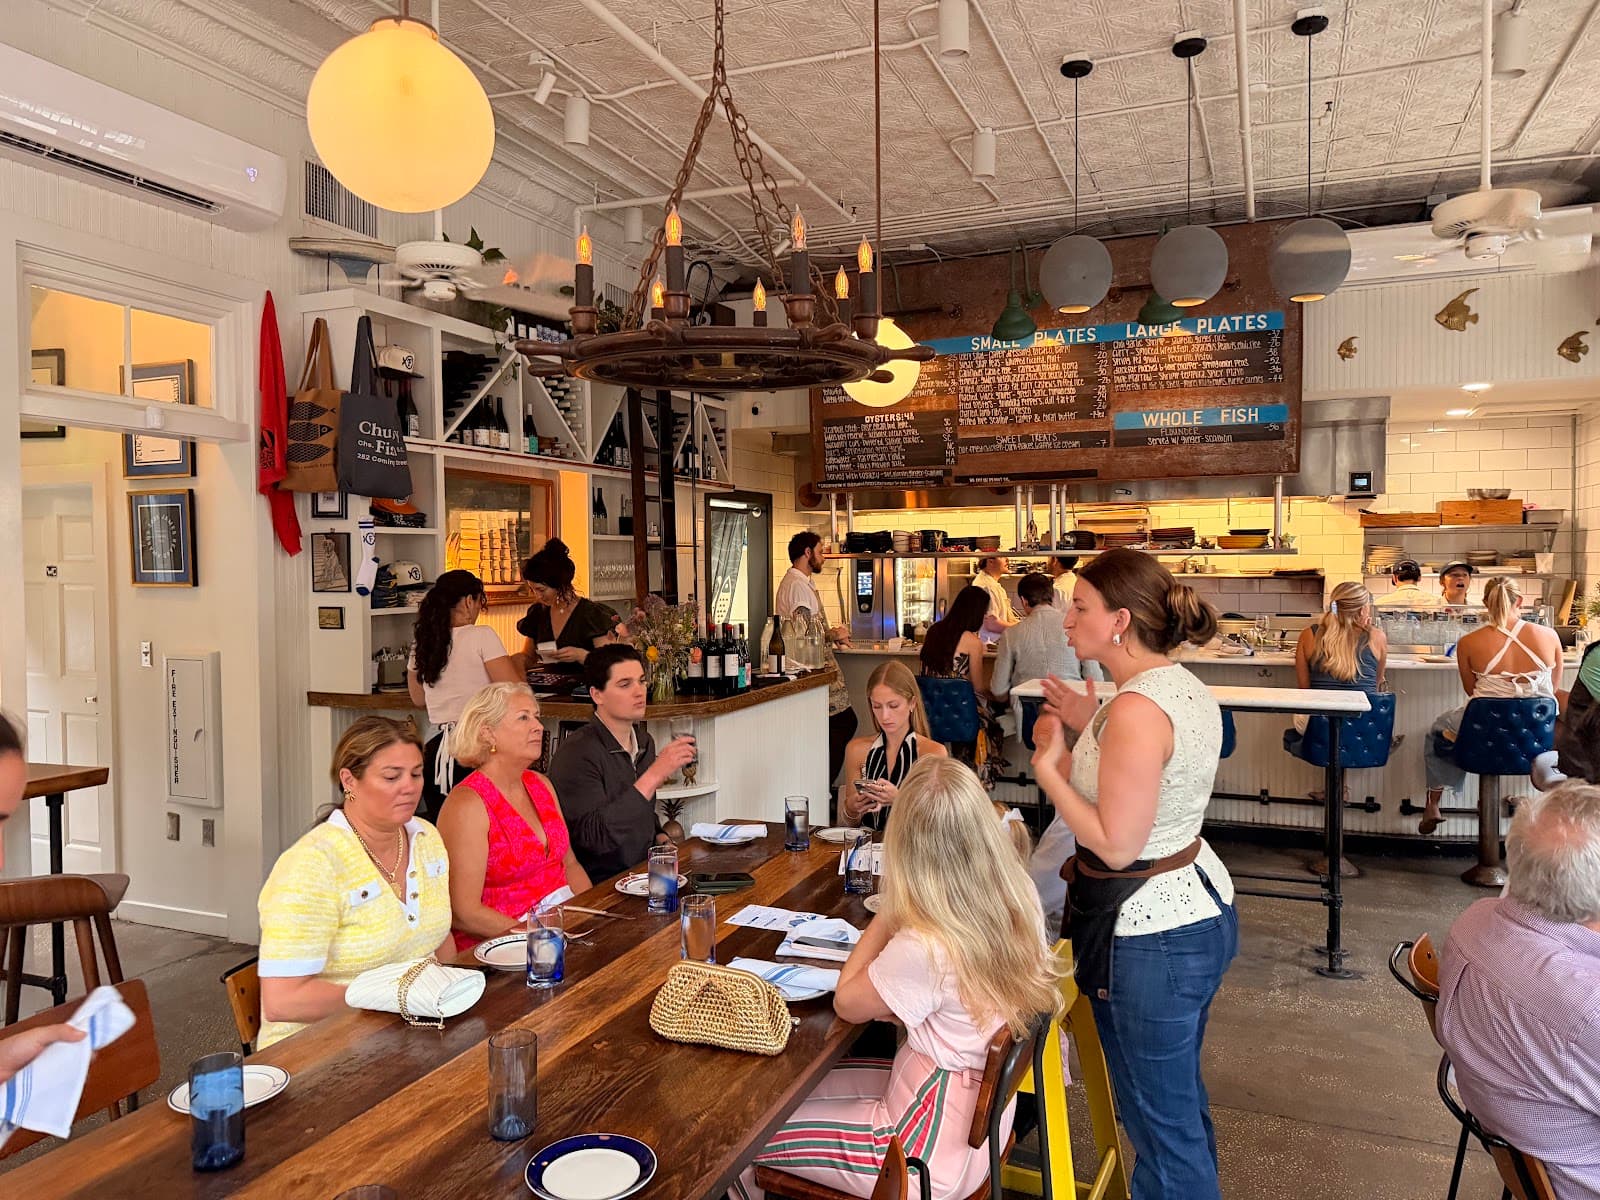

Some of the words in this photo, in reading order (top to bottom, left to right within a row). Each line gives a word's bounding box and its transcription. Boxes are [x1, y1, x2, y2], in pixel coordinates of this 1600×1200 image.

[1126, 320, 1181, 338] LARGE
[1197, 314, 1268, 333] PLATES
[971, 337, 1020, 351] SMALL
[1142, 410, 1204, 427] WHOLE
[1221, 408, 1259, 423] FISH
[996, 435, 1021, 444] SWEET
[1031, 432, 1058, 442] TREATS
[1160, 426, 1200, 437] FLOUNDER
[1096, 439, 1108, 447] -7
[357, 453, 371, 461] 282
[172, 700, 180, 784] EXTINGUISHER
